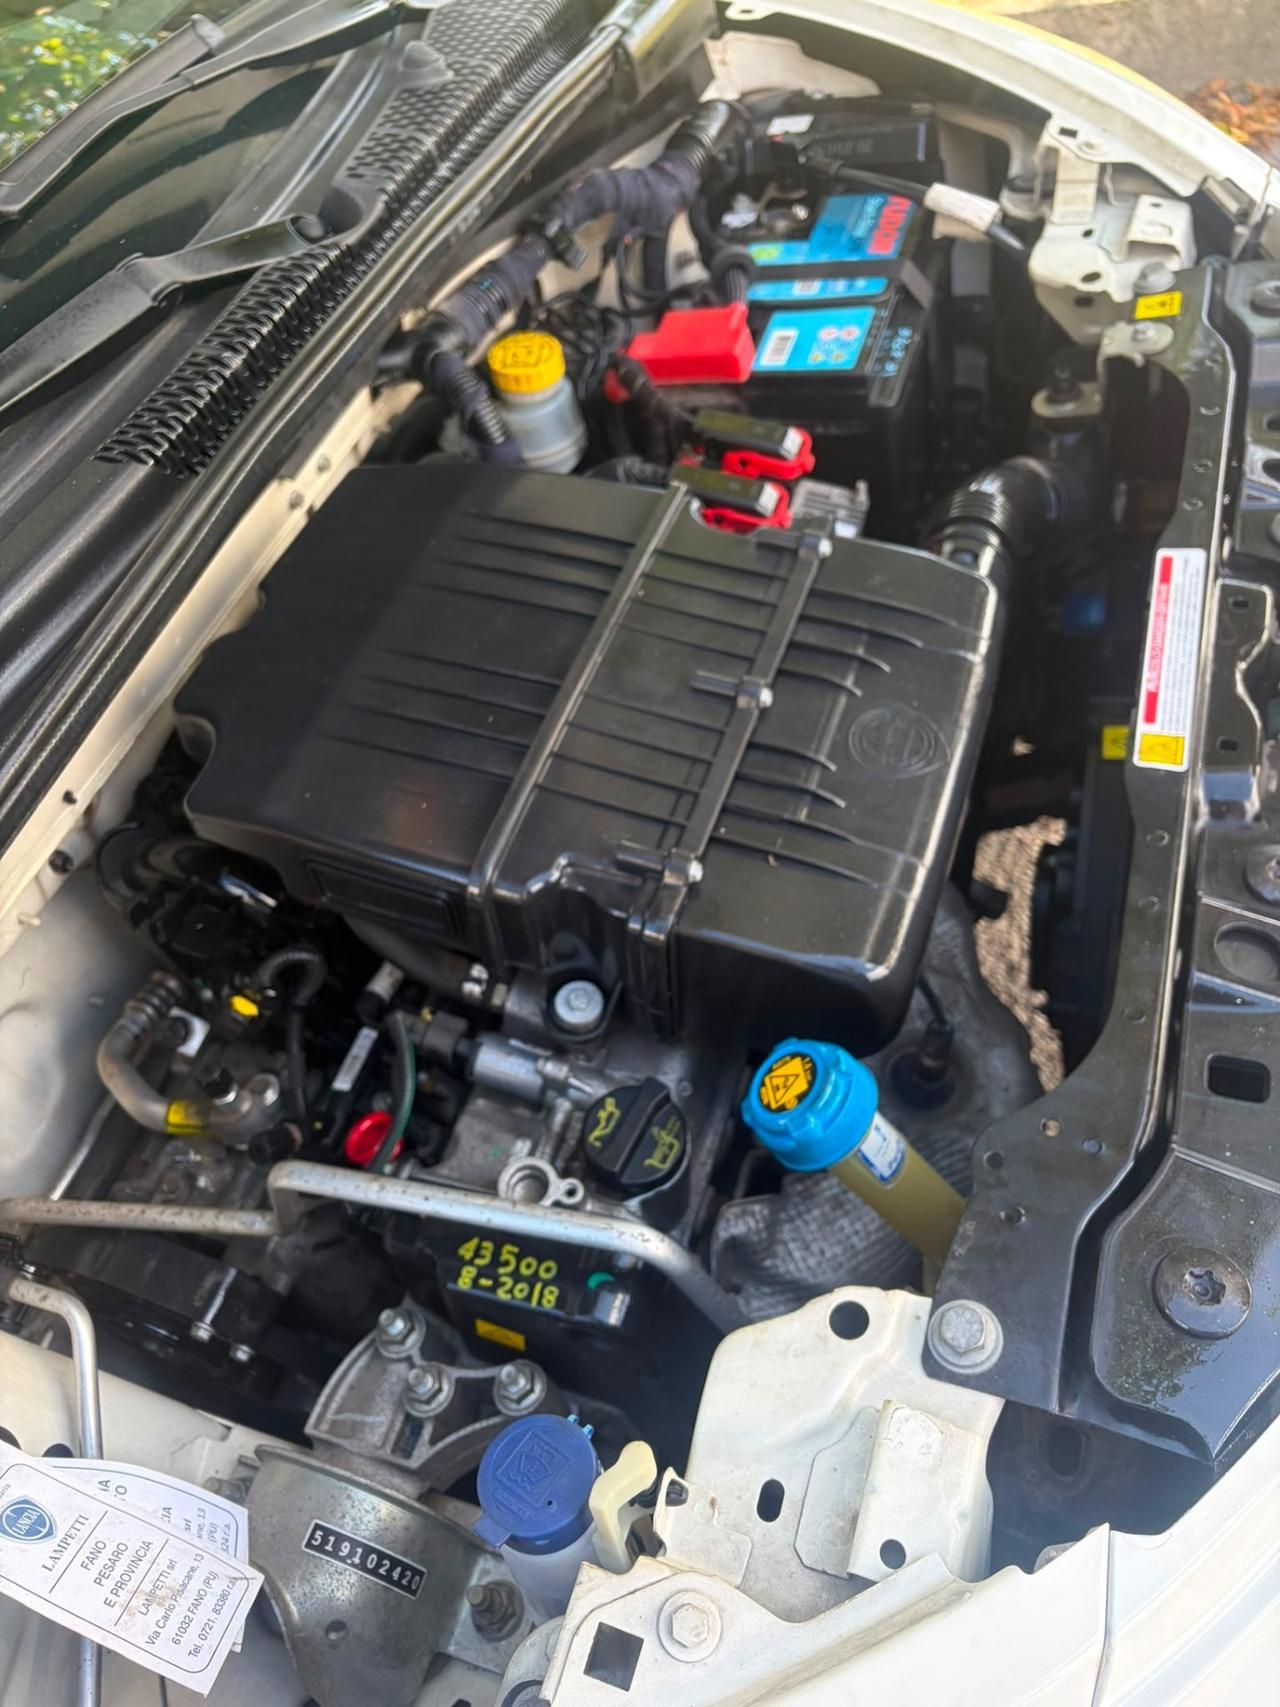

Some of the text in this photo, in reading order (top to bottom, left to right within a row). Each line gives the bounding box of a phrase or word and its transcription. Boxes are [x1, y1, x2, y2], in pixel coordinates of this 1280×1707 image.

[457, 1265, 560, 1309] 8-2018
[12, 1509, 41, 1535] LANCIA
[41, 1514, 89, 1572] LAMPETTI
[80, 1540, 106, 1571] FANO
[93, 1542, 128, 1587] PESARO
[103, 1541, 154, 1608] E PROVINCIA
[311, 1530, 421, 1590] 519102420
[138, 1558, 178, 1616] LAMPETTI srl
[145, 1553, 204, 1645] Via Carlo Pisacane, 13
[171, 1570, 219, 1646] 61032 FANO (PU)
[187, 1643, 204, 1658] Tel.
[198, 1616, 218, 1642] 0721.
[211, 1589, 231, 1615] 83380
